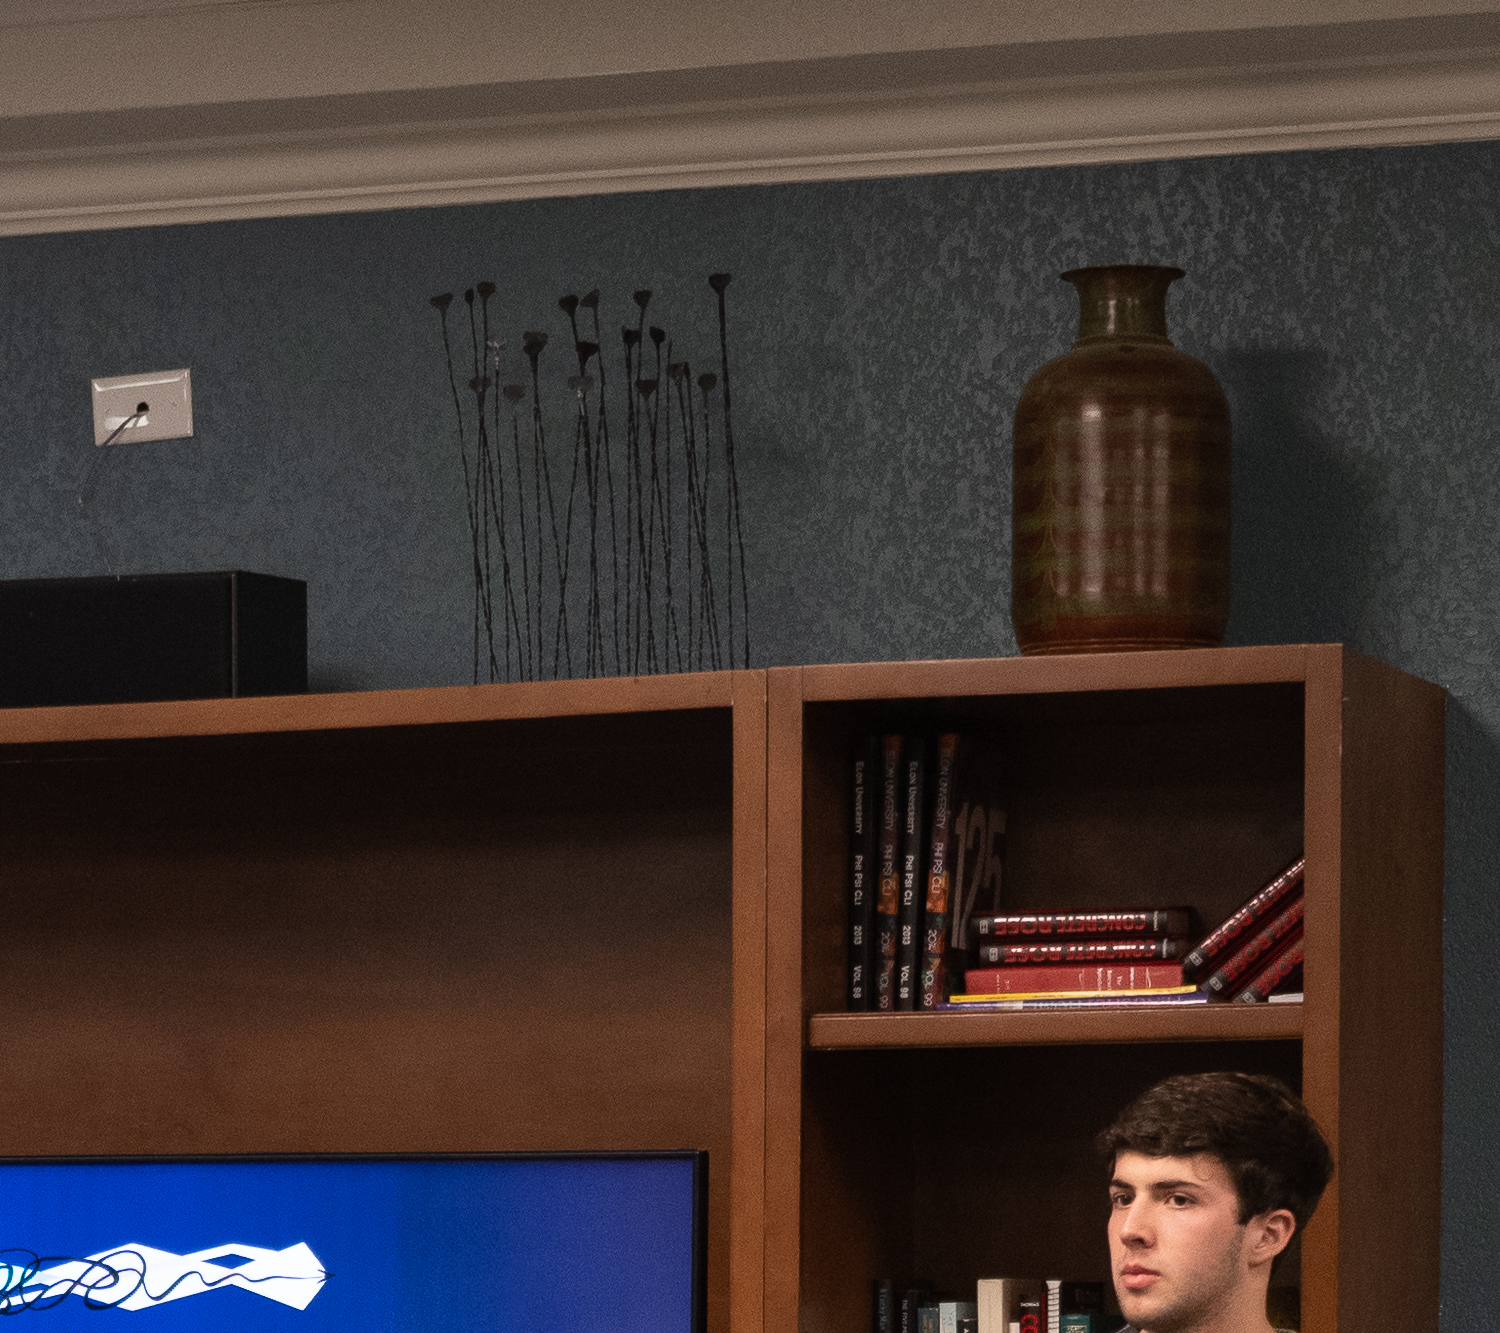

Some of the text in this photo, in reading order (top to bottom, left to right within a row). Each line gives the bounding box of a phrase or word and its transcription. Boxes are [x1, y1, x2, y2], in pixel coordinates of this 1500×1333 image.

[855, 855, 863, 871] PHI
[905, 855, 915, 871] PHI
[854, 873, 863, 888] PSI
[904, 873, 914, 888] PSI
[854, 890, 863, 906] CLI
[903, 890, 913, 906] CLI
[994, 912, 1146, 936] CONCRETE ROSE
[1004, 940, 1156, 963] CONCRETE ROSE
